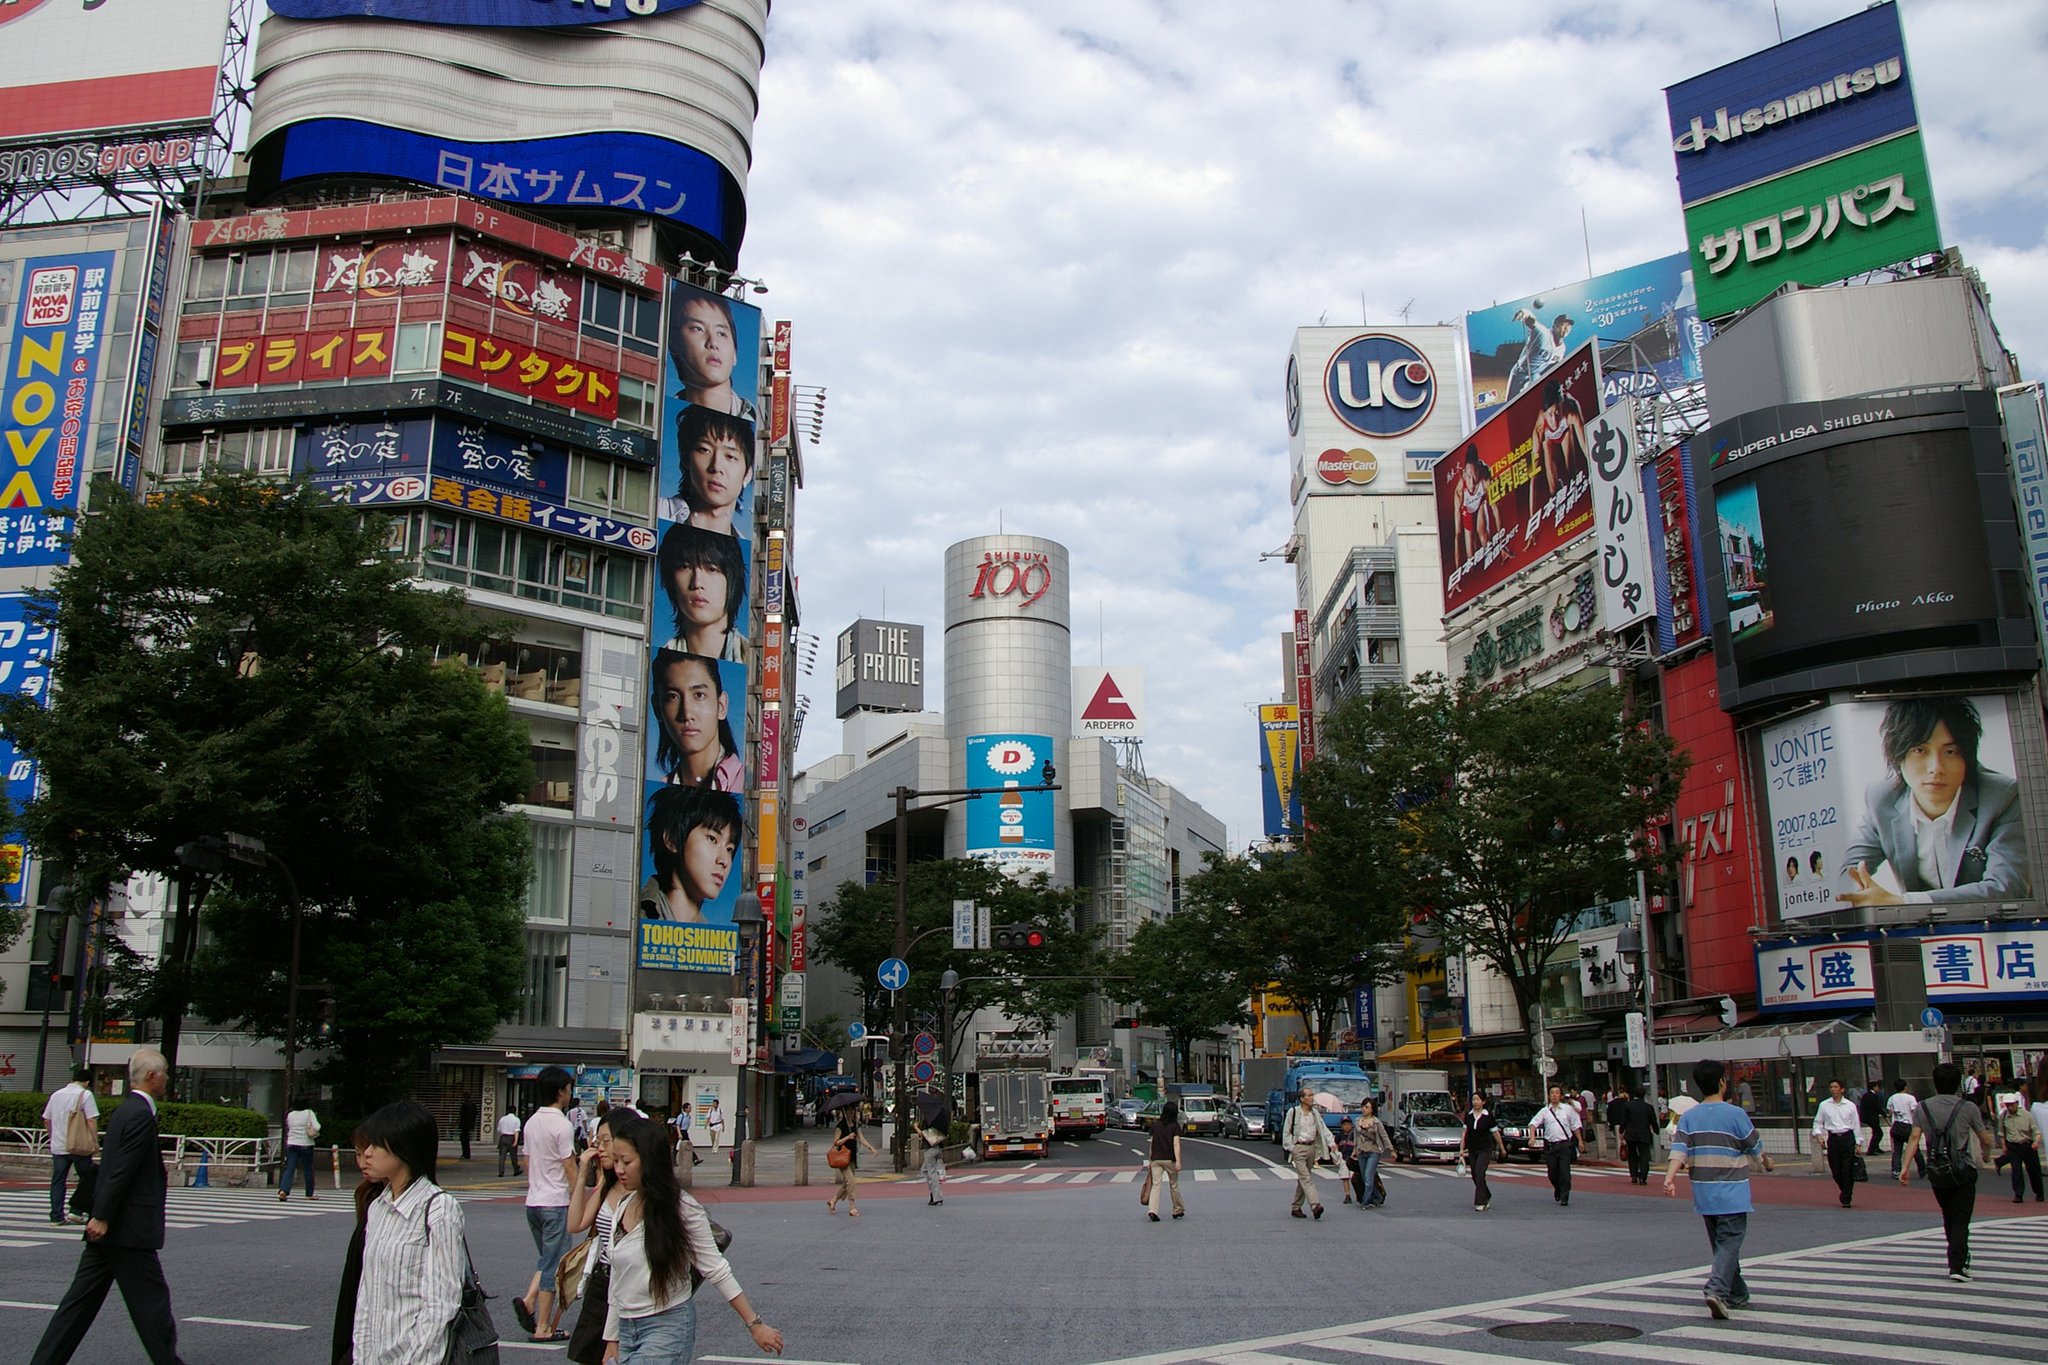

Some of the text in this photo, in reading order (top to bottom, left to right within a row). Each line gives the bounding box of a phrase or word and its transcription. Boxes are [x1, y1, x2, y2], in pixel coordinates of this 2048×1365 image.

[1672, 56, 1901, 152] Hisamitsu
[99, 137, 192, 175] group
[436, 150, 687, 215] 日本サムスン
[1700, 173, 1915, 275] サロンパス
[33, 282, 72, 294] 駅前留学
[41, 273, 67, 284] こども
[32, 294, 69, 308] NOVA
[33, 306, 64, 320] KIDS
[73, 268, 105, 354] 駅前留学
[221, 332, 388, 378] プライス
[444, 330, 612, 403] コンタクト
[411, 388, 427, 401] 7F
[446, 390, 462, 404] 7F
[1602, 373, 1659, 398] ARIUS
[0, 331, 66, 509] NOVA
[1728, 408, 1895, 462] SUPER LISA SHIBUYA
[52, 379, 87, 500] お茶の間留学
[1319, 459, 1378, 472] MasterCard
[1487, 451, 1542, 507] 世界陸上
[392, 480, 420, 497] 6F
[431, 477, 651, 545] 英会話イーオン 6F
[772, 518, 781, 526] 7F
[1591, 419, 1642, 615] もんじゃ
[984, 551, 1049, 564] SHIBUYA
[968, 561, 1052, 608] 109
[1855, 591, 1955, 614] Photo Akko
[765, 630, 781, 672] 歯科
[876, 626, 909, 656] THE
[864, 652, 920, 685] PRIME
[765, 688, 779, 698] 6F
[764, 711, 779, 719] 5F
[1084, 721, 1134, 730] ARDEPRO
[1273, 706, 1289, 720] 薬
[1002, 750, 1021, 764] D
[1770, 726, 1834, 768] JONTE
[1772, 758, 1827, 791] って誰!?
[1777, 807, 1837, 837] 2007.8.22
[1681, 779, 1735, 907] クスリ
[1779, 830, 1817, 850] デビュー!
[1784, 886, 1831, 910] jonte.jp
[642, 923, 737, 951] TOHOSHINKI
[962, 904, 971, 945] 渋谷駅前
[793, 932, 803, 958] アコム
[1778, 942, 2036, 994] 大盛 書店
[1360, 991, 1369, 1029] みずほ銀行
[733, 1005, 741, 1056] 道玄坂
